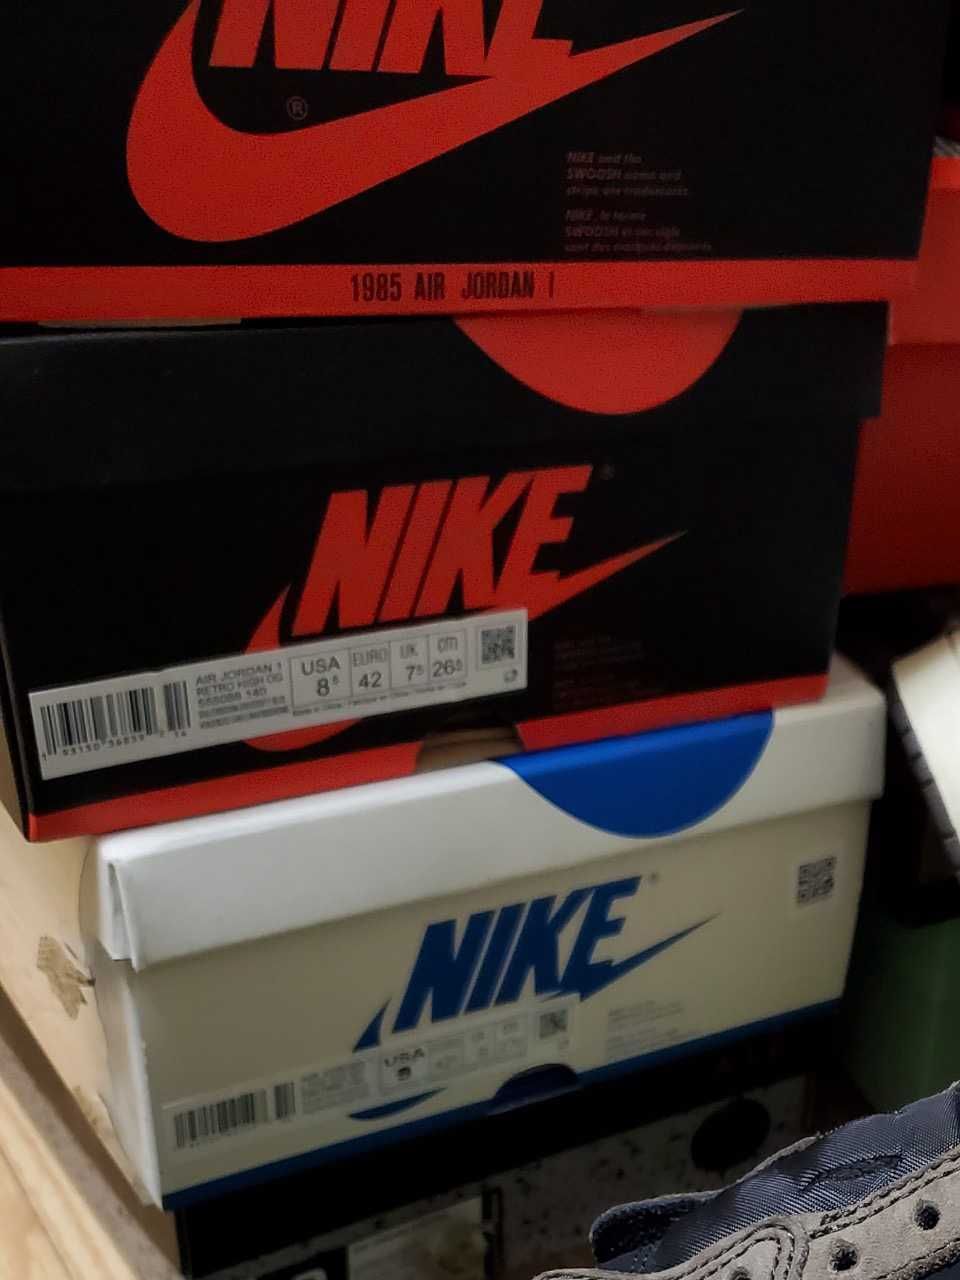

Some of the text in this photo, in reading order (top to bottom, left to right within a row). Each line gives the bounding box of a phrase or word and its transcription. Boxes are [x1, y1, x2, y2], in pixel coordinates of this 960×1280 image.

[352, 272, 402, 301] 1985
[415, 271, 445, 300] AIR
[462, 270, 535, 299] JORDAN
[292, 464, 593, 637] NIKE
[301, 655, 341, 677] USA
[352, 646, 388, 668] EURO
[196, 672, 217, 686] AIR
[221, 663, 272, 682] JORDAN
[358, 670, 382, 689] 42
[392, 875, 642, 1034] NIKE
[384, 1047, 425, 1068] USA
